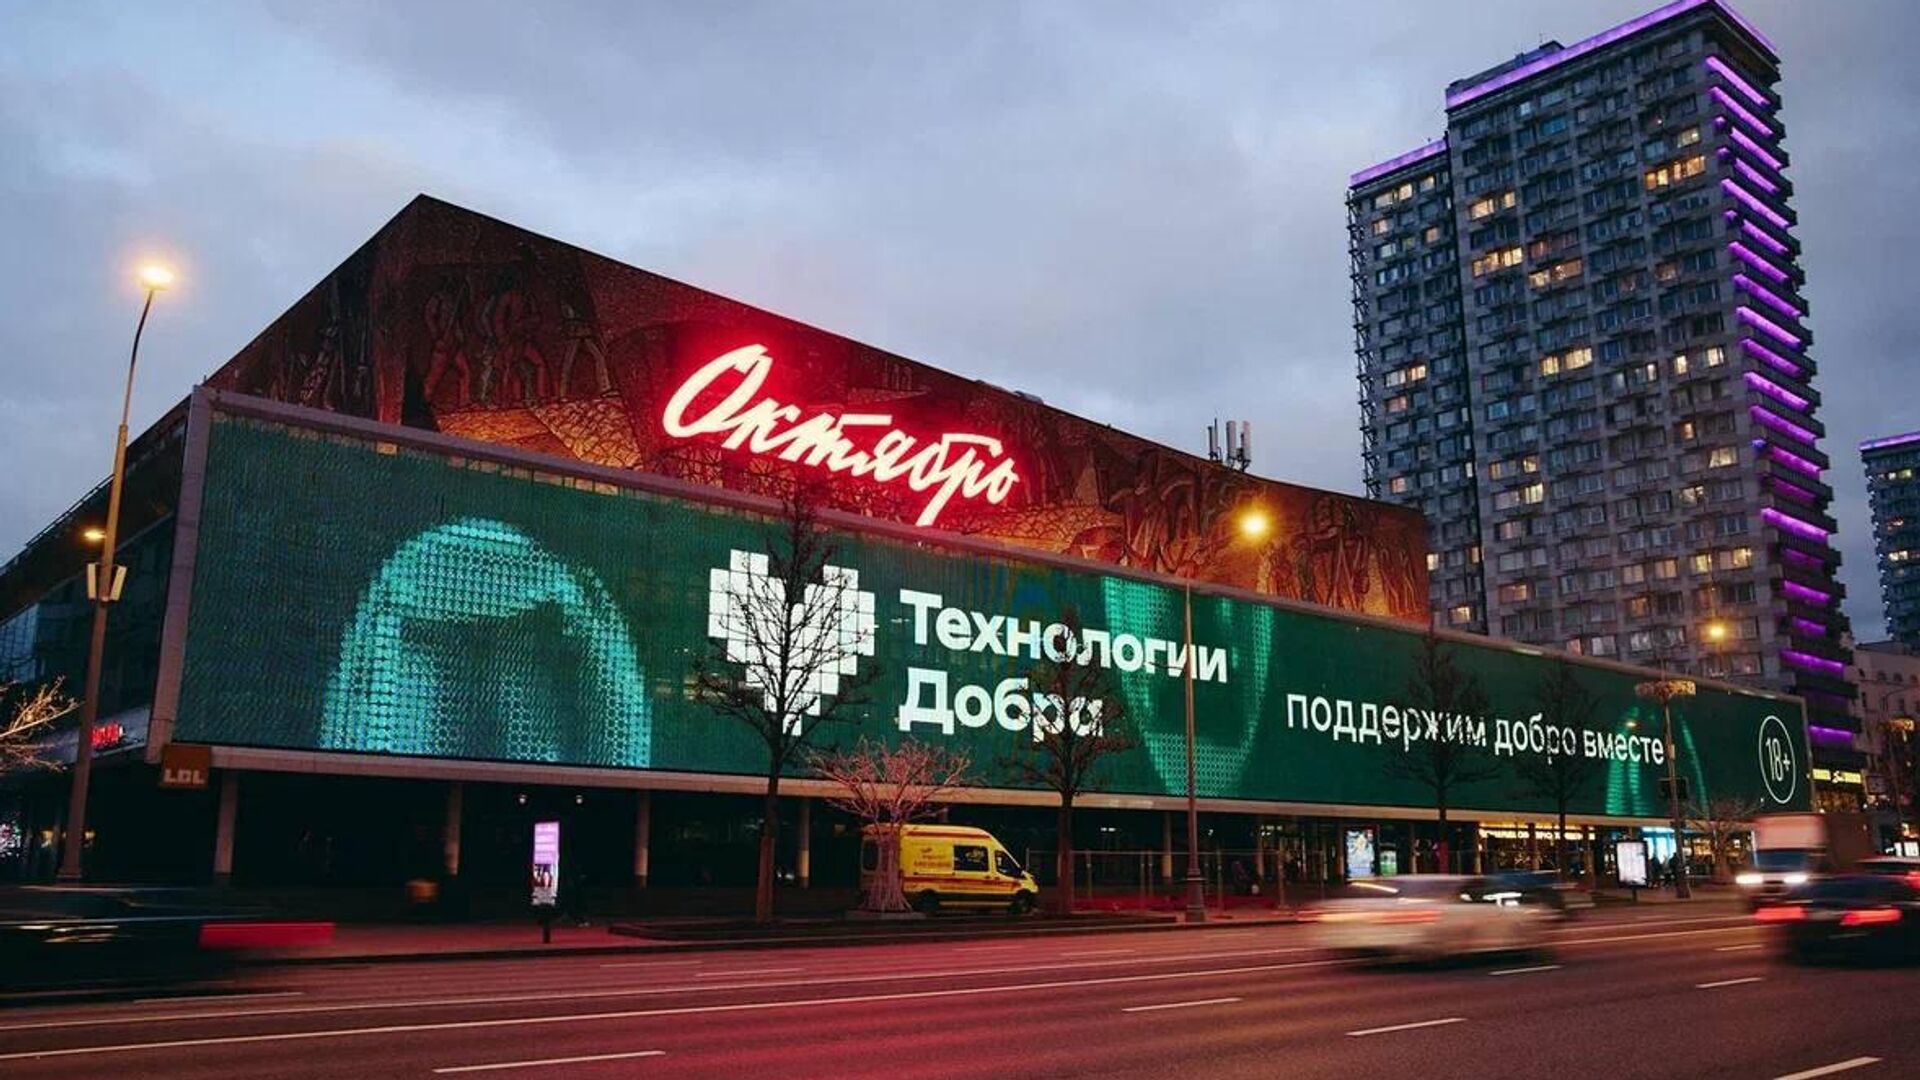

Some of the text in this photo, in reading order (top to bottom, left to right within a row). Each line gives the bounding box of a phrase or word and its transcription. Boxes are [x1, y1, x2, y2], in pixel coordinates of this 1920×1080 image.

[662, 343, 1020, 527] Октябрь
[900, 588, 1228, 683] Технологии
[898, 667, 1103, 742] Добра
[1286, 693, 1665, 765] поддержим добро вместе
[1765, 737, 1791, 782] 18+
